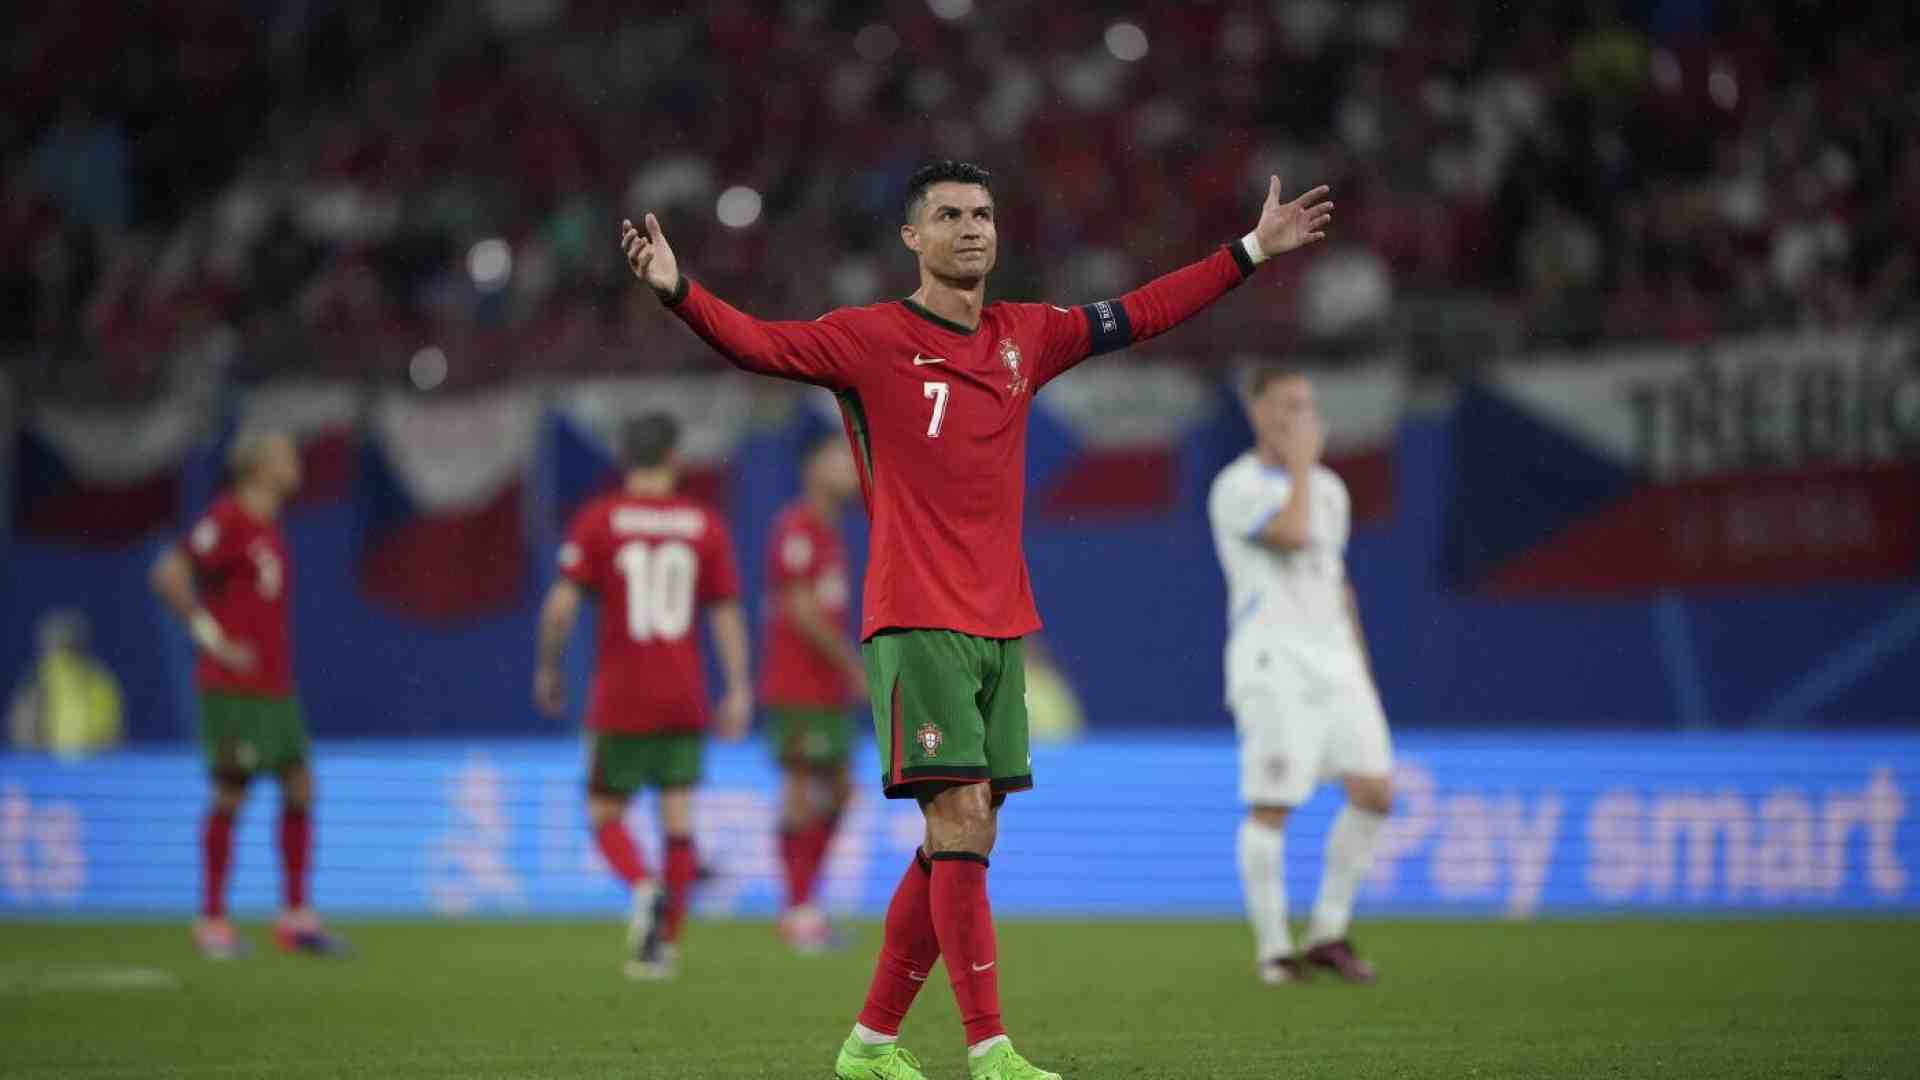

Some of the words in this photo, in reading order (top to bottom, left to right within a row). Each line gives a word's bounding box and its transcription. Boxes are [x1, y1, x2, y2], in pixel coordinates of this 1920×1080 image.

[923, 381, 949, 438] 7
[613, 541, 699, 641] 10
[1587, 765, 1908, 900] smart
